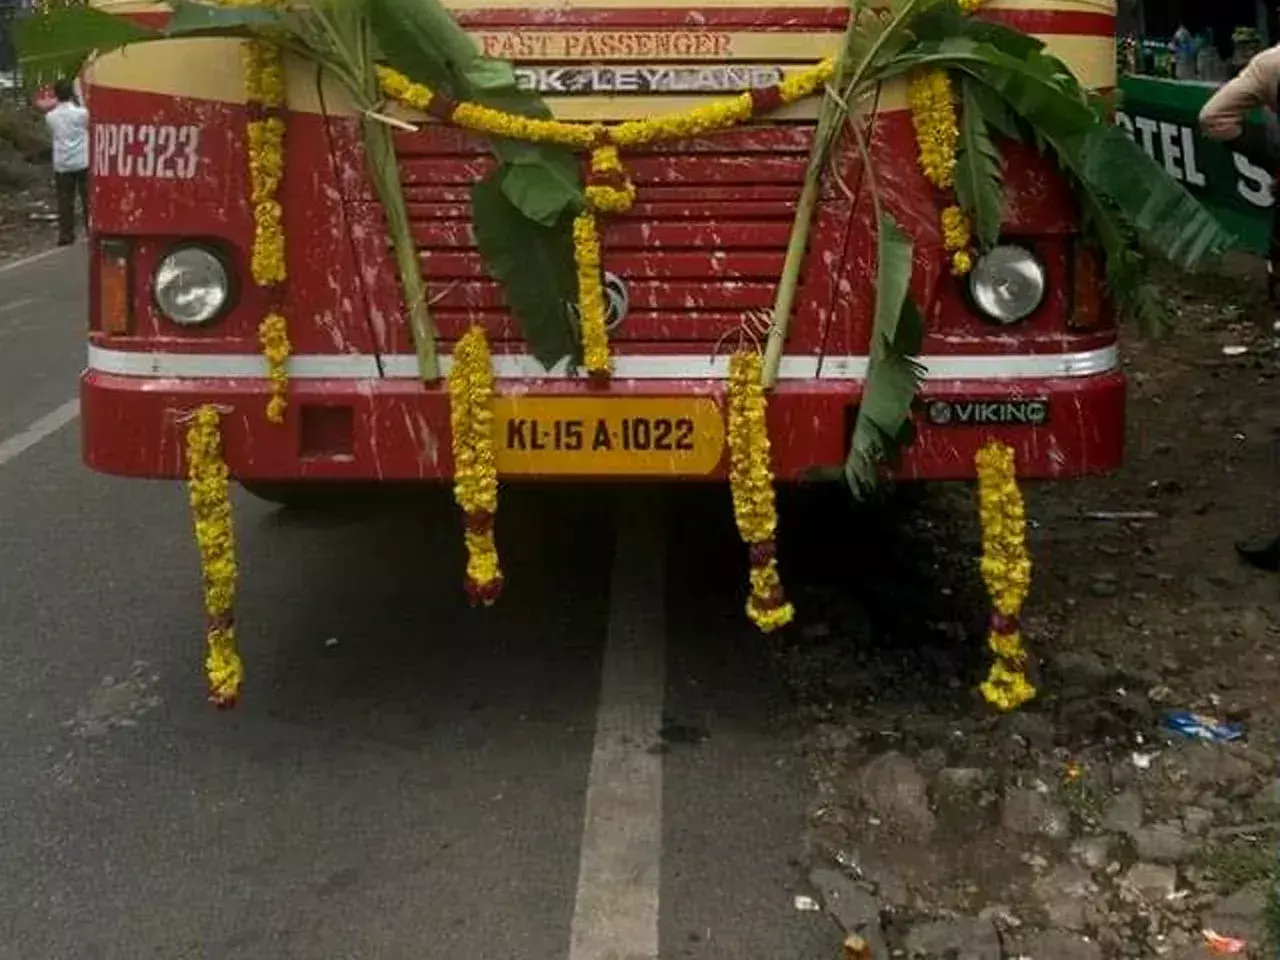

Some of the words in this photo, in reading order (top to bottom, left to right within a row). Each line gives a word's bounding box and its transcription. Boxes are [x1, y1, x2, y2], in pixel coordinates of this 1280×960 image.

[484, 34, 551, 58] FAST
[563, 31, 734, 56] PASSENGER
[592, 67, 782, 92] LEYLAND
[955, 402, 1046, 422] VIKING
